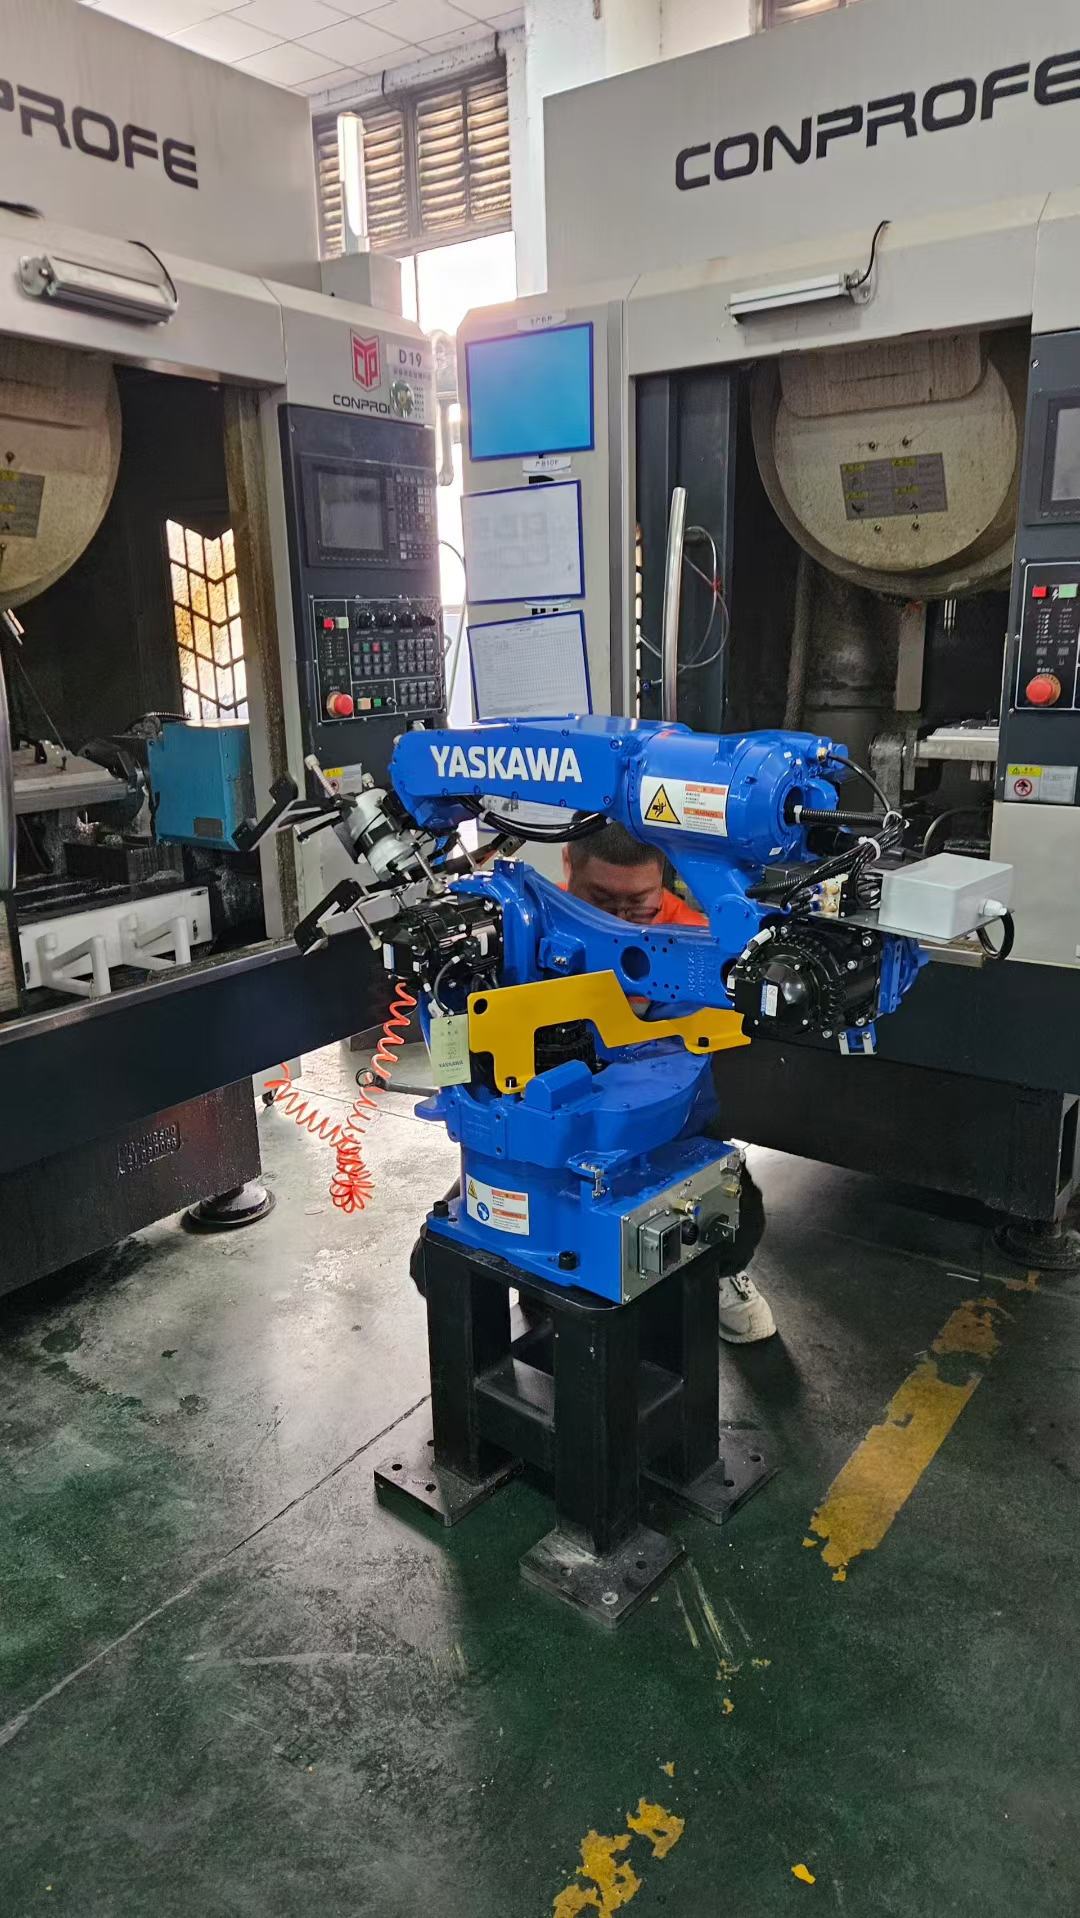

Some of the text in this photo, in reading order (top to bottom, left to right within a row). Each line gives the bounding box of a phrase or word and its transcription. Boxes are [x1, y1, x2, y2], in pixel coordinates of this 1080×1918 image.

[675, 50, 1080, 191] CONPROFE
[398, 348, 422, 367] D19
[430, 745, 583, 783] YASKAWA
